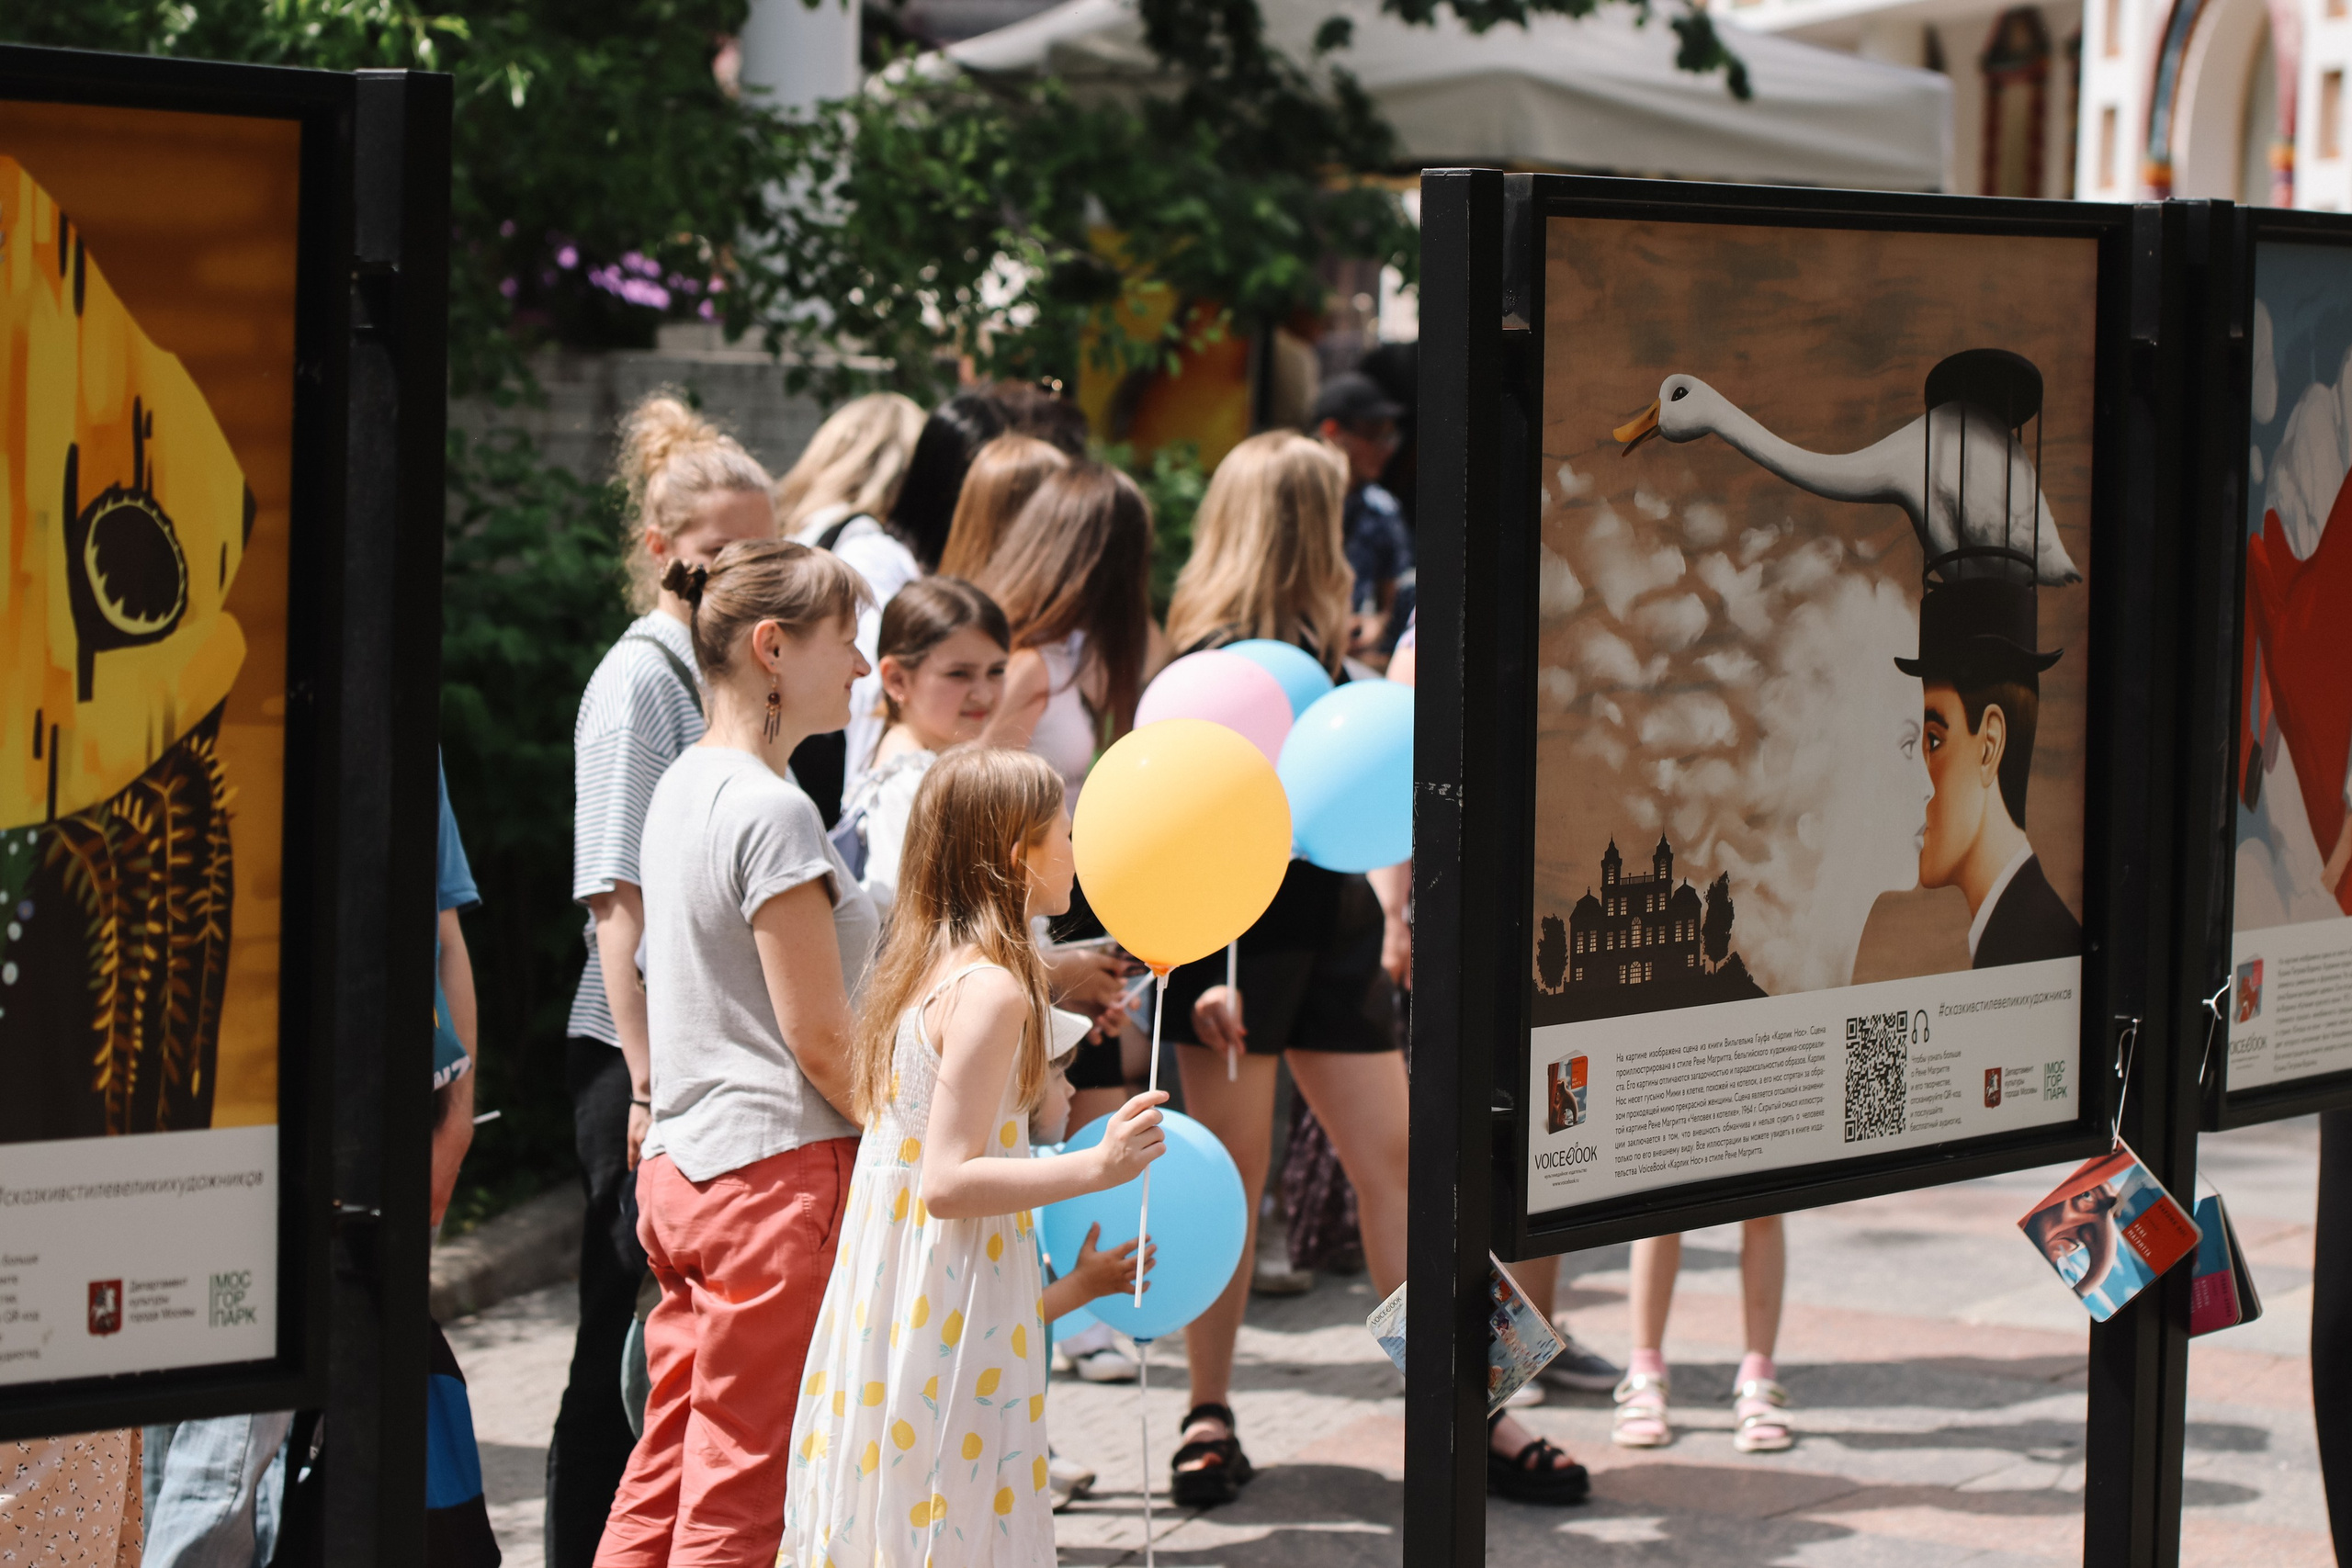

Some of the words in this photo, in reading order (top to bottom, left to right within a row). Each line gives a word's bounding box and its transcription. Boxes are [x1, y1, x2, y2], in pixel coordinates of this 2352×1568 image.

[1939, 989, 2072, 1017] #сказкивстилевеликихудожников
[2047, 1060, 2065, 1074] МОС
[2047, 1074, 2062, 1087] ГОР
[2047, 1086, 2068, 1101] ПАРК
[1535, 1145, 1597, 1170] VOICEBOOK
[215, 1269, 252, 1290] МОС
[215, 1290, 245, 1309] ГОР
[215, 1306, 258, 1328] ПАРК
